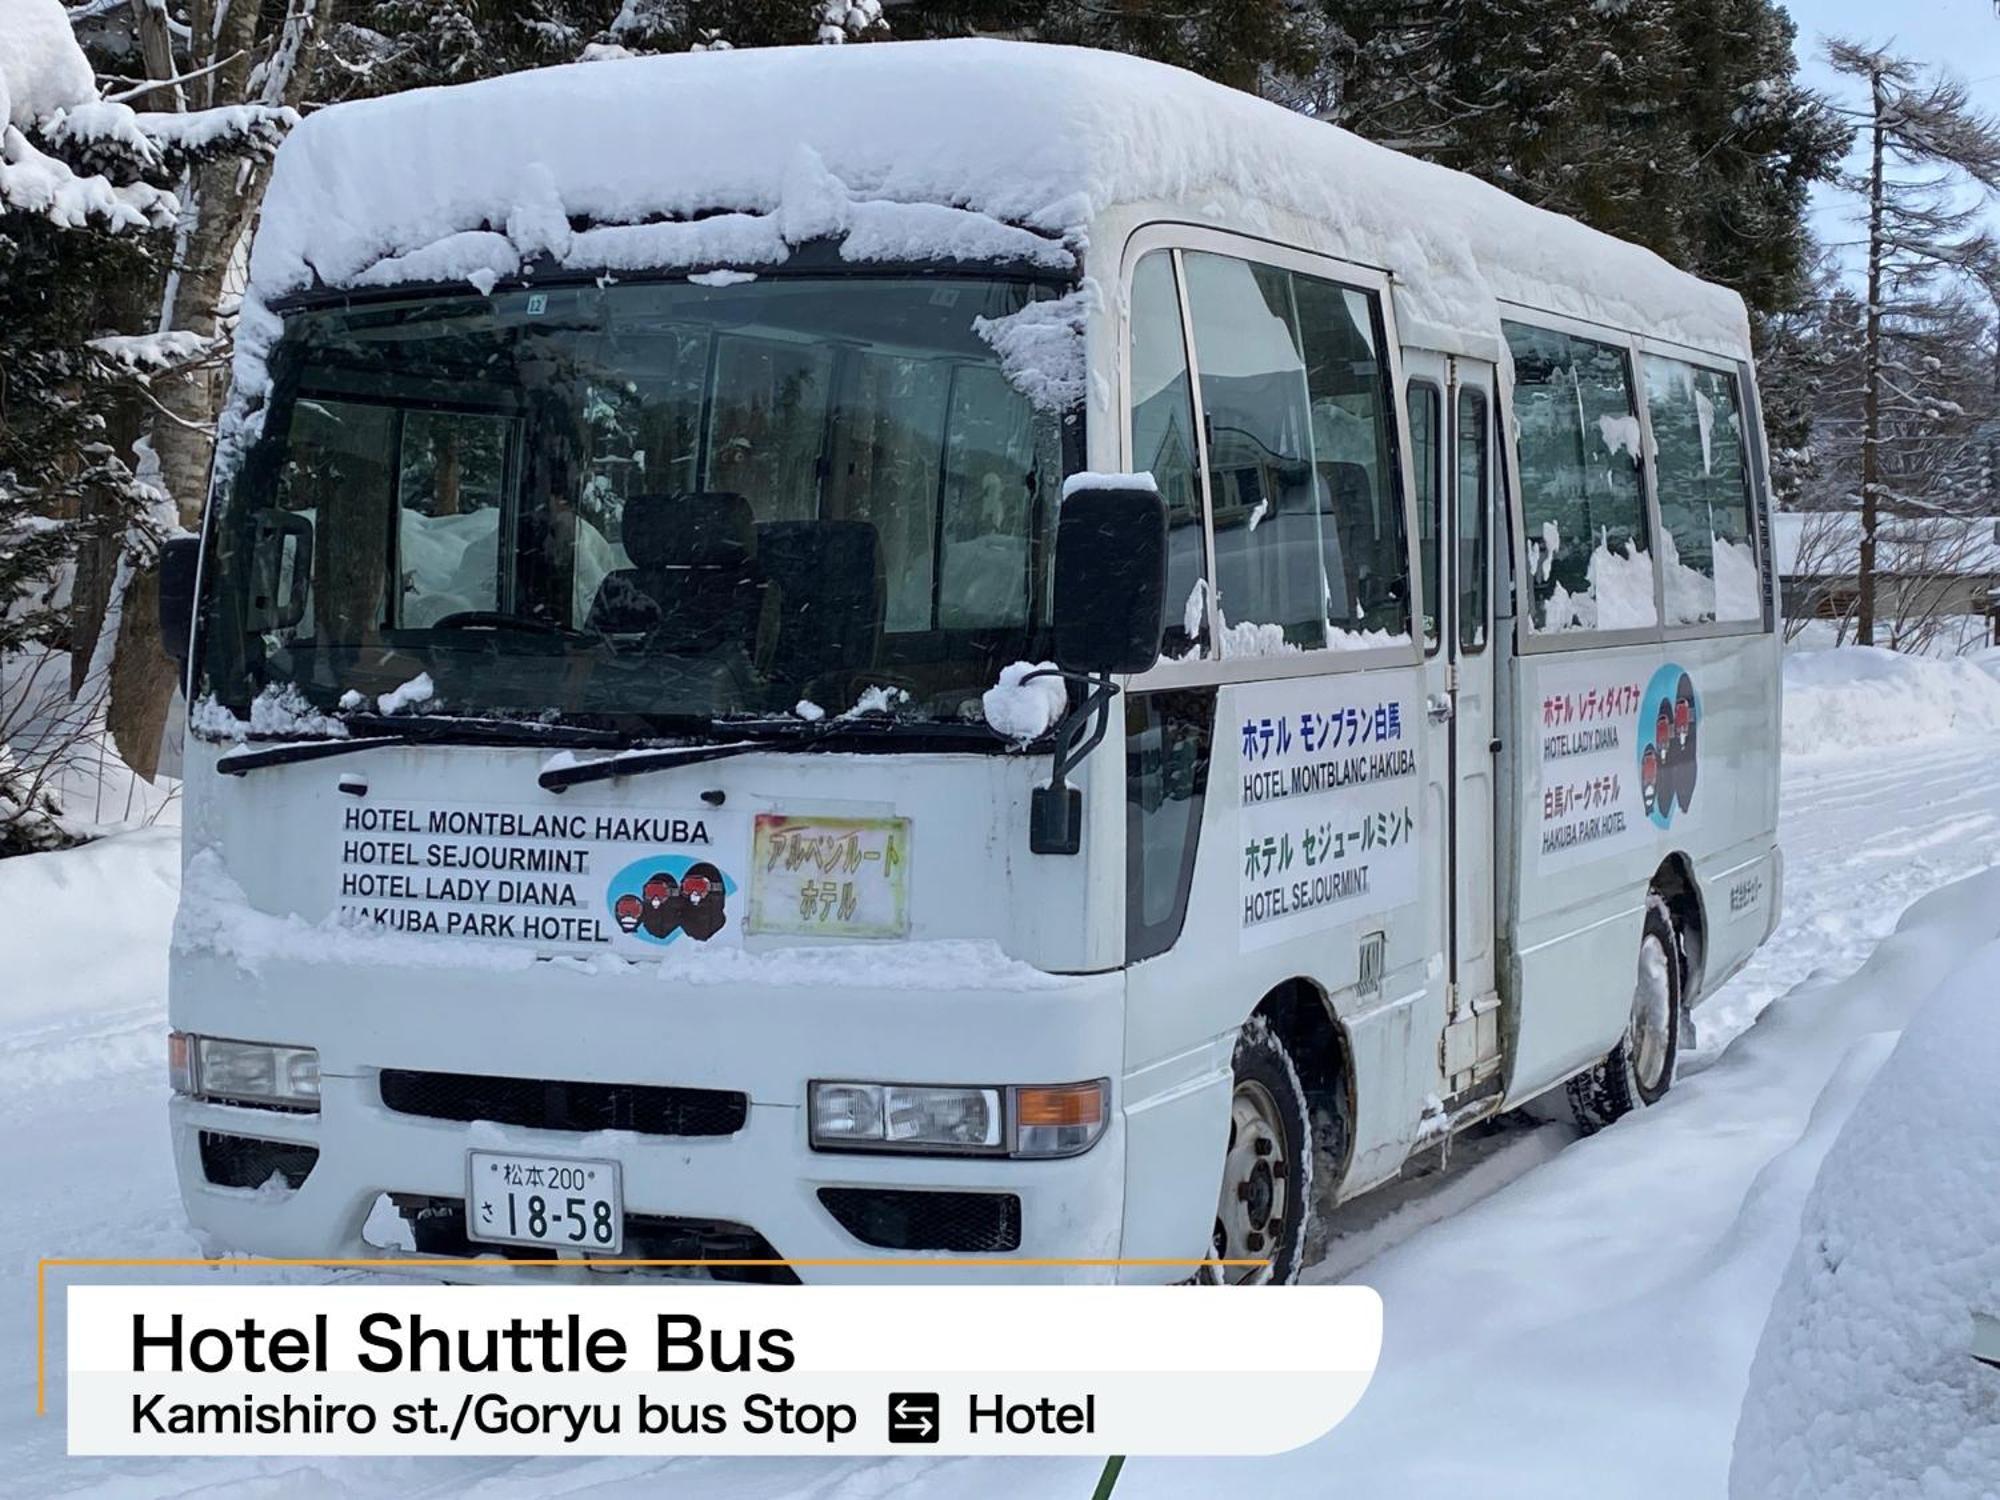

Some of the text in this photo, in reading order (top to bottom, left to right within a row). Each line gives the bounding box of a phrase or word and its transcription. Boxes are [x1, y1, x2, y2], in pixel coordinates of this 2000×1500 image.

[1543, 684, 1641, 728] ホテル レディダイアナ
[1242, 701, 1401, 761] ホテル モンブラン白馬
[1543, 725, 1620, 761] HOTEL LADY DIANA
[1244, 749, 1416, 803] HOTEL MONTBLANC HAKUBA
[345, 807, 710, 844] HOTEL MONTBLANC HAKUBA
[1244, 806, 1414, 880] ホテル セジュールミント
[1542, 811, 1627, 854] HAKUBA PARK HOTEL
[343, 841, 590, 874] HOTEL SEJOURMINT
[341, 873, 577, 907] HOTEL LADY DIANA
[801, 879, 857, 921] ホテル
[1244, 865, 1369, 923] HOTEL SEJOURMINT
[447, 911, 516, 938] PARK
[523, 917, 609, 943] HOTEL
[504, 1163, 586, 1191] 松本200
[482, 1193, 613, 1244] さ 18-58
